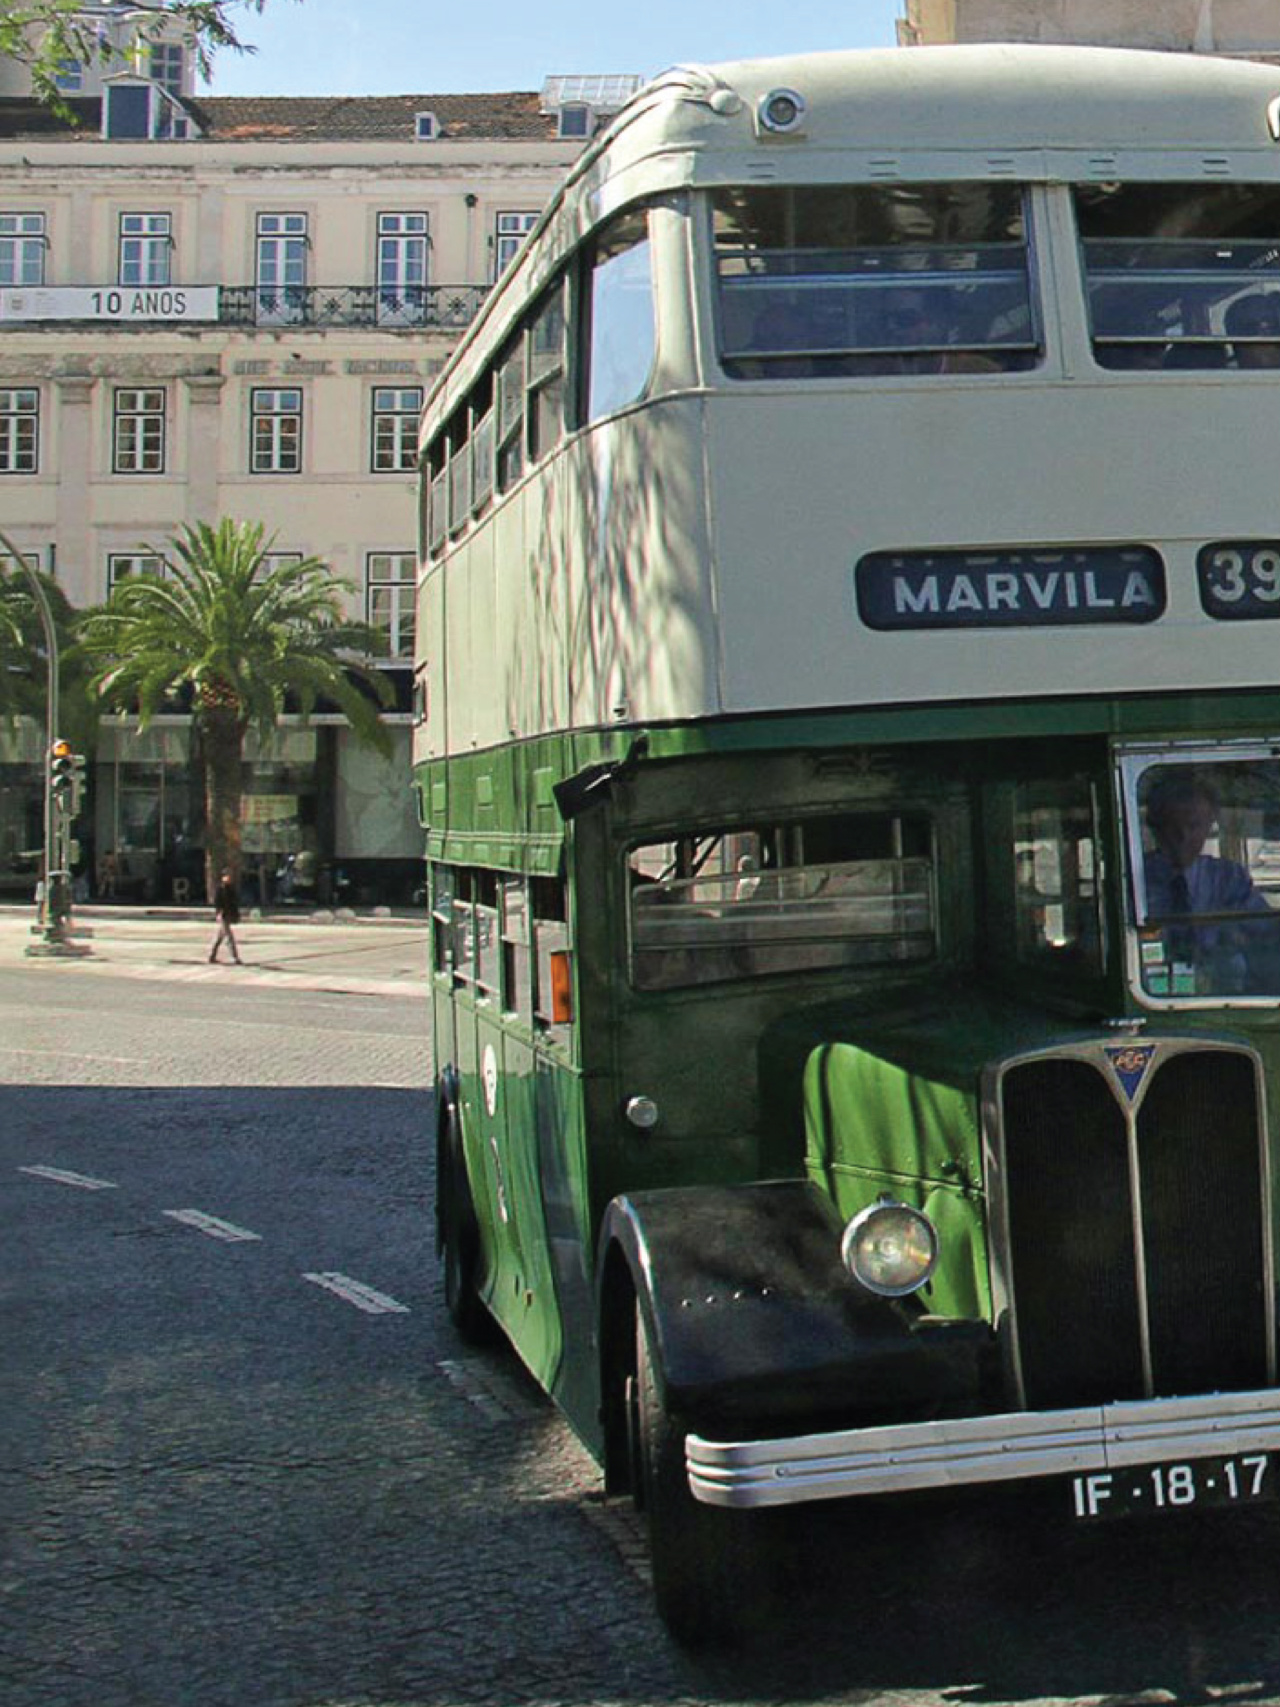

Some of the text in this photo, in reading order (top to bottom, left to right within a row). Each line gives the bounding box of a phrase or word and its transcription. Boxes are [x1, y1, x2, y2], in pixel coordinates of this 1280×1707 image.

[92, 291, 187, 314] 10 ANOS
[892, 570, 1155, 613] MARVILA
